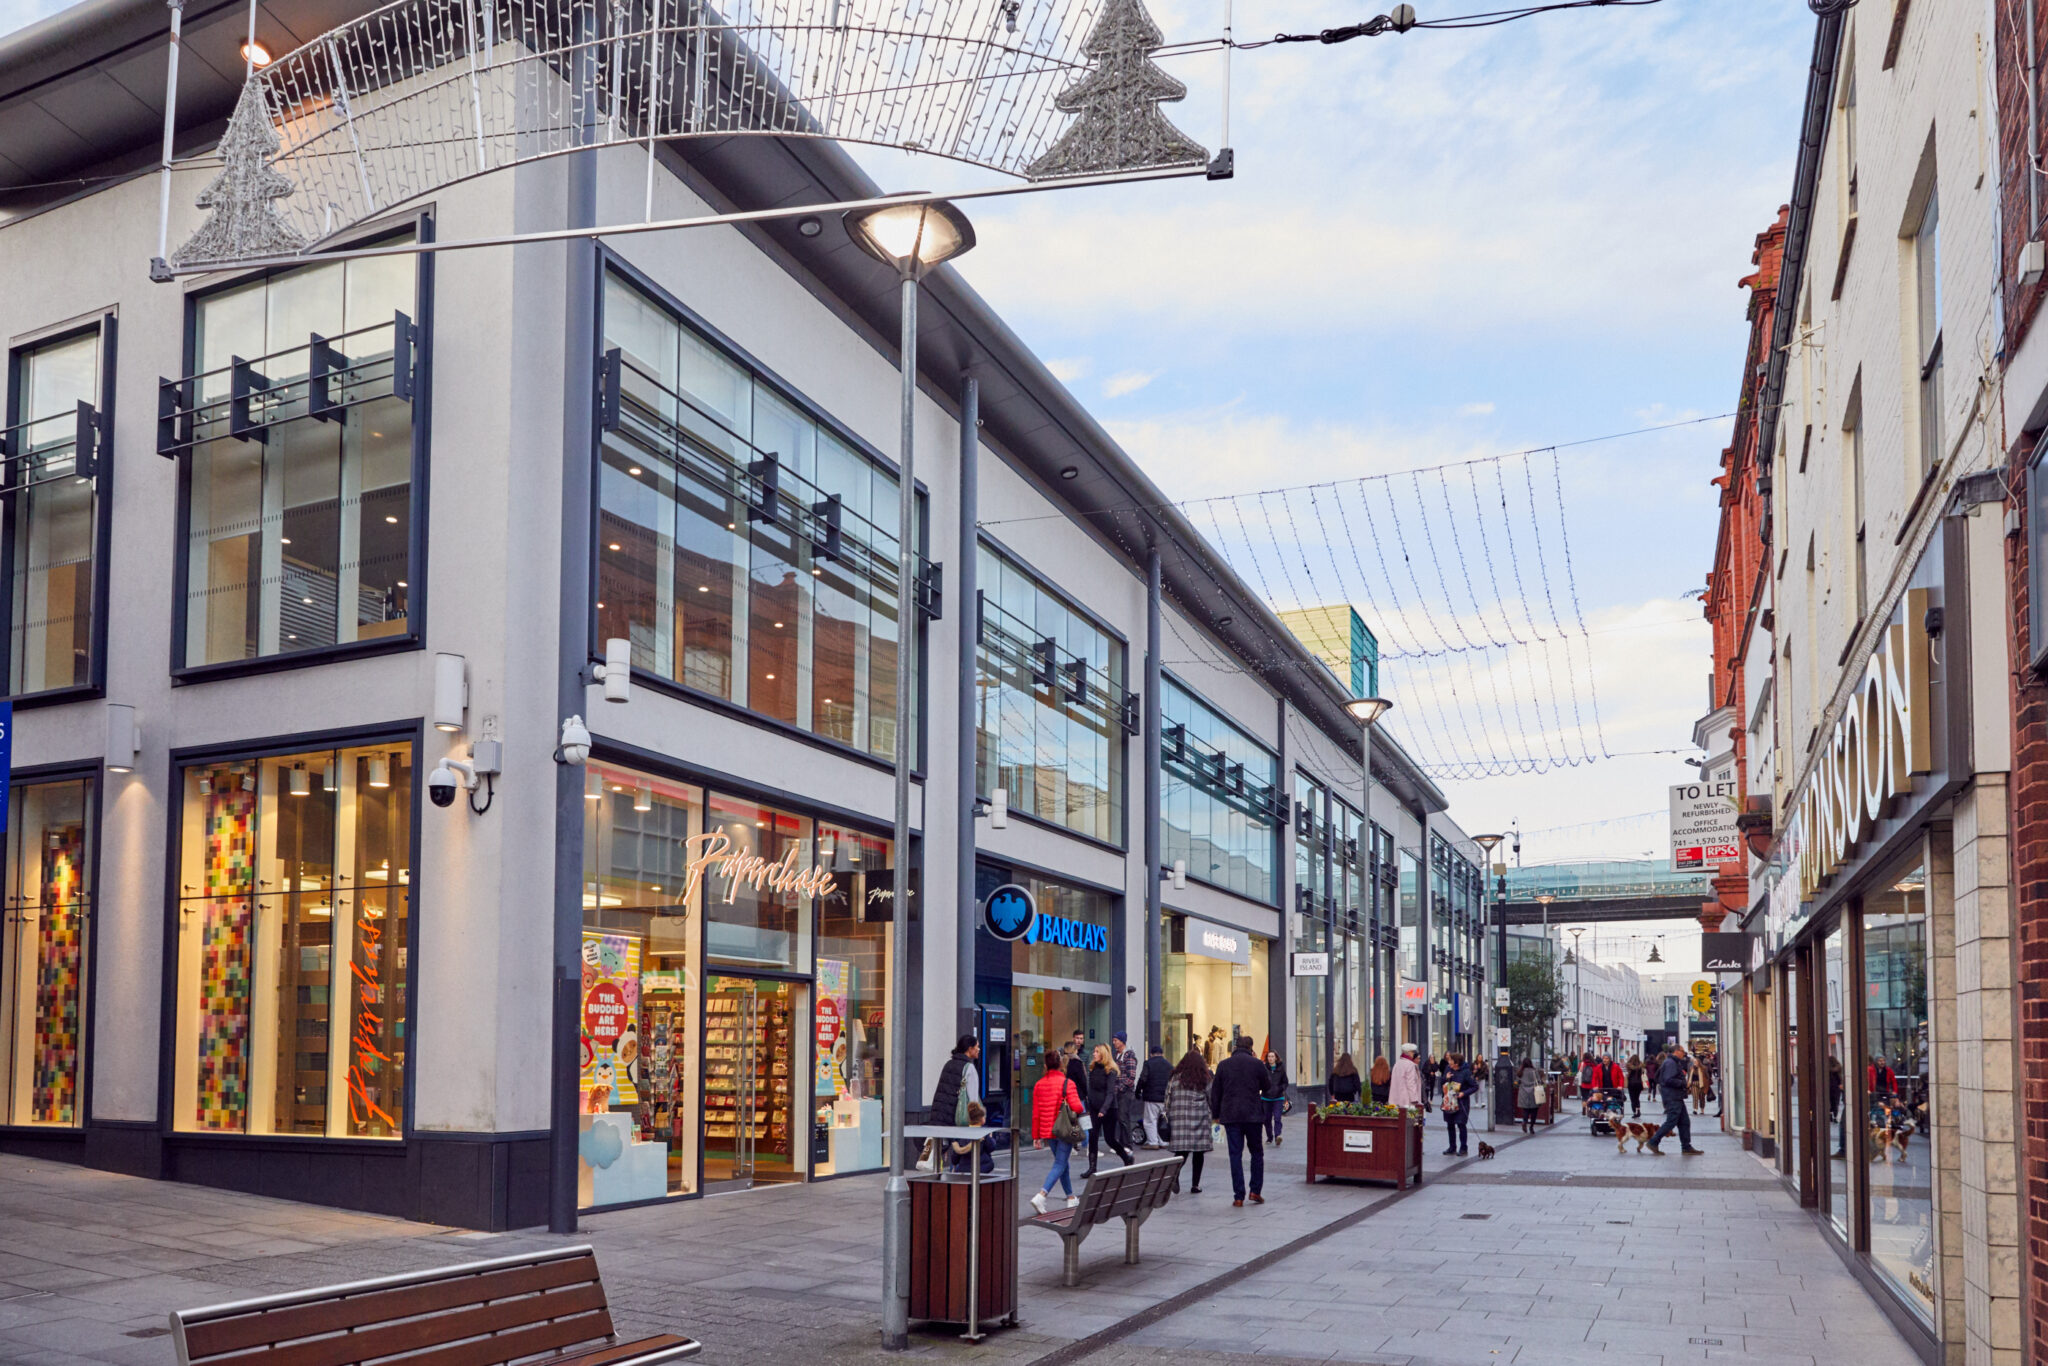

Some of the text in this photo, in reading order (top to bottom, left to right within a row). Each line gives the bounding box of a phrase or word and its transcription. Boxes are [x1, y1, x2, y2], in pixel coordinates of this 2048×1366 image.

[1798, 585, 1931, 902] MONSOON
[1676, 782, 1736, 800] TO LET
[1693, 802, 1719, 810] NEWLY
[1682, 808, 1731, 818] REFURBISHED
[1694, 819, 1718, 827] OFFICE
[1696, 837, 1716, 846] 1,570
[683, 825, 838, 905] Paperchase
[1043, 913, 1108, 952] BARCLAYS
[1707, 959, 1742, 968] Clarks
[599, 994, 615, 1003] THE
[343, 898, 395, 1127] Paperchase
[588, 1004, 625, 1015] BUDDIES
[599, 1016, 615, 1025] ARE
[595, 1027, 619, 1037] HERE!
[821, 1024, 832, 1032] ARE
